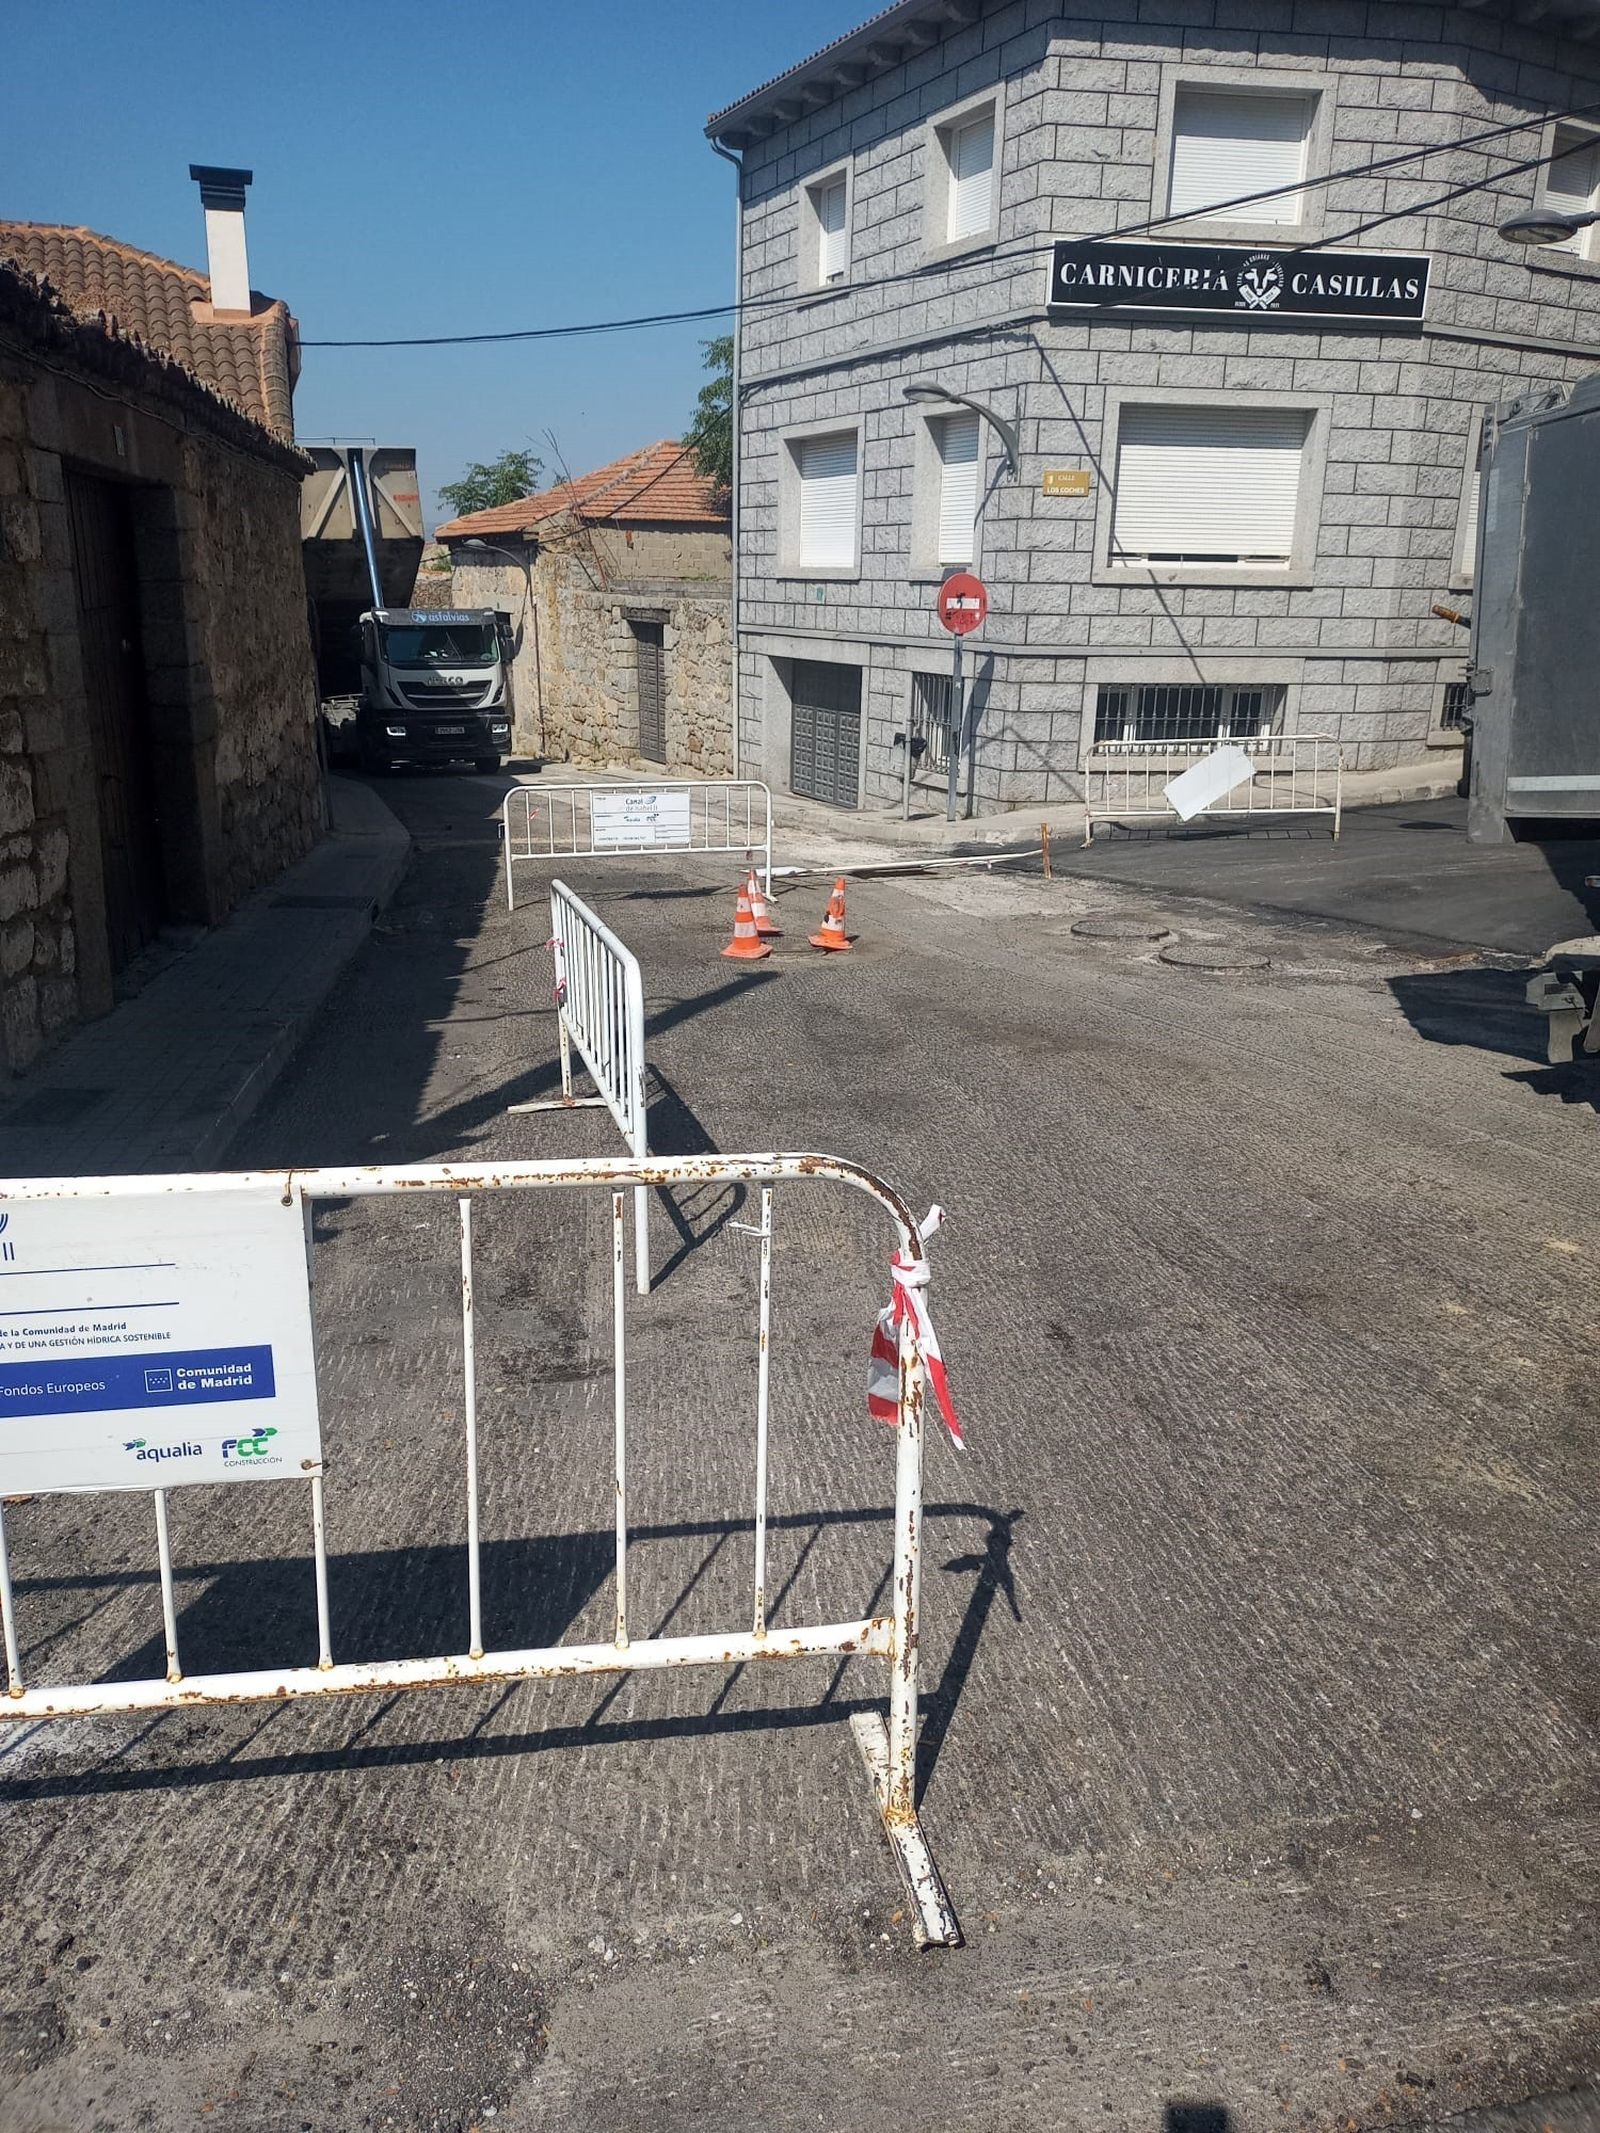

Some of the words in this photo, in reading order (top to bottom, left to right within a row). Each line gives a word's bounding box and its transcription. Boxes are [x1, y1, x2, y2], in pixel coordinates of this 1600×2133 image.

[1292, 273, 1419, 300] CASILLAS
[11, 1329, 20, 1337] la
[22, 1325, 76, 1336] Comunidad
[93, 1322, 127, 1332] Madrid
[15, 1341, 27, 1349] DE
[28, 1340, 47, 1348] UNA
[48, 1336, 85, 1347] GESTIÓN
[87, 1335, 122, 1345] HÍDRICA
[123, 1331, 172, 1343] SOSTENIBLE
[176, 1363, 252, 1378] Comunidad
[46, 1379, 106, 1395] Europeos
[177, 1380, 197, 1390] de
[201, 1375, 253, 1389] Madrid
[136, 1441, 202, 1463] aqualia
[221, 1437, 269, 1459] FCC
